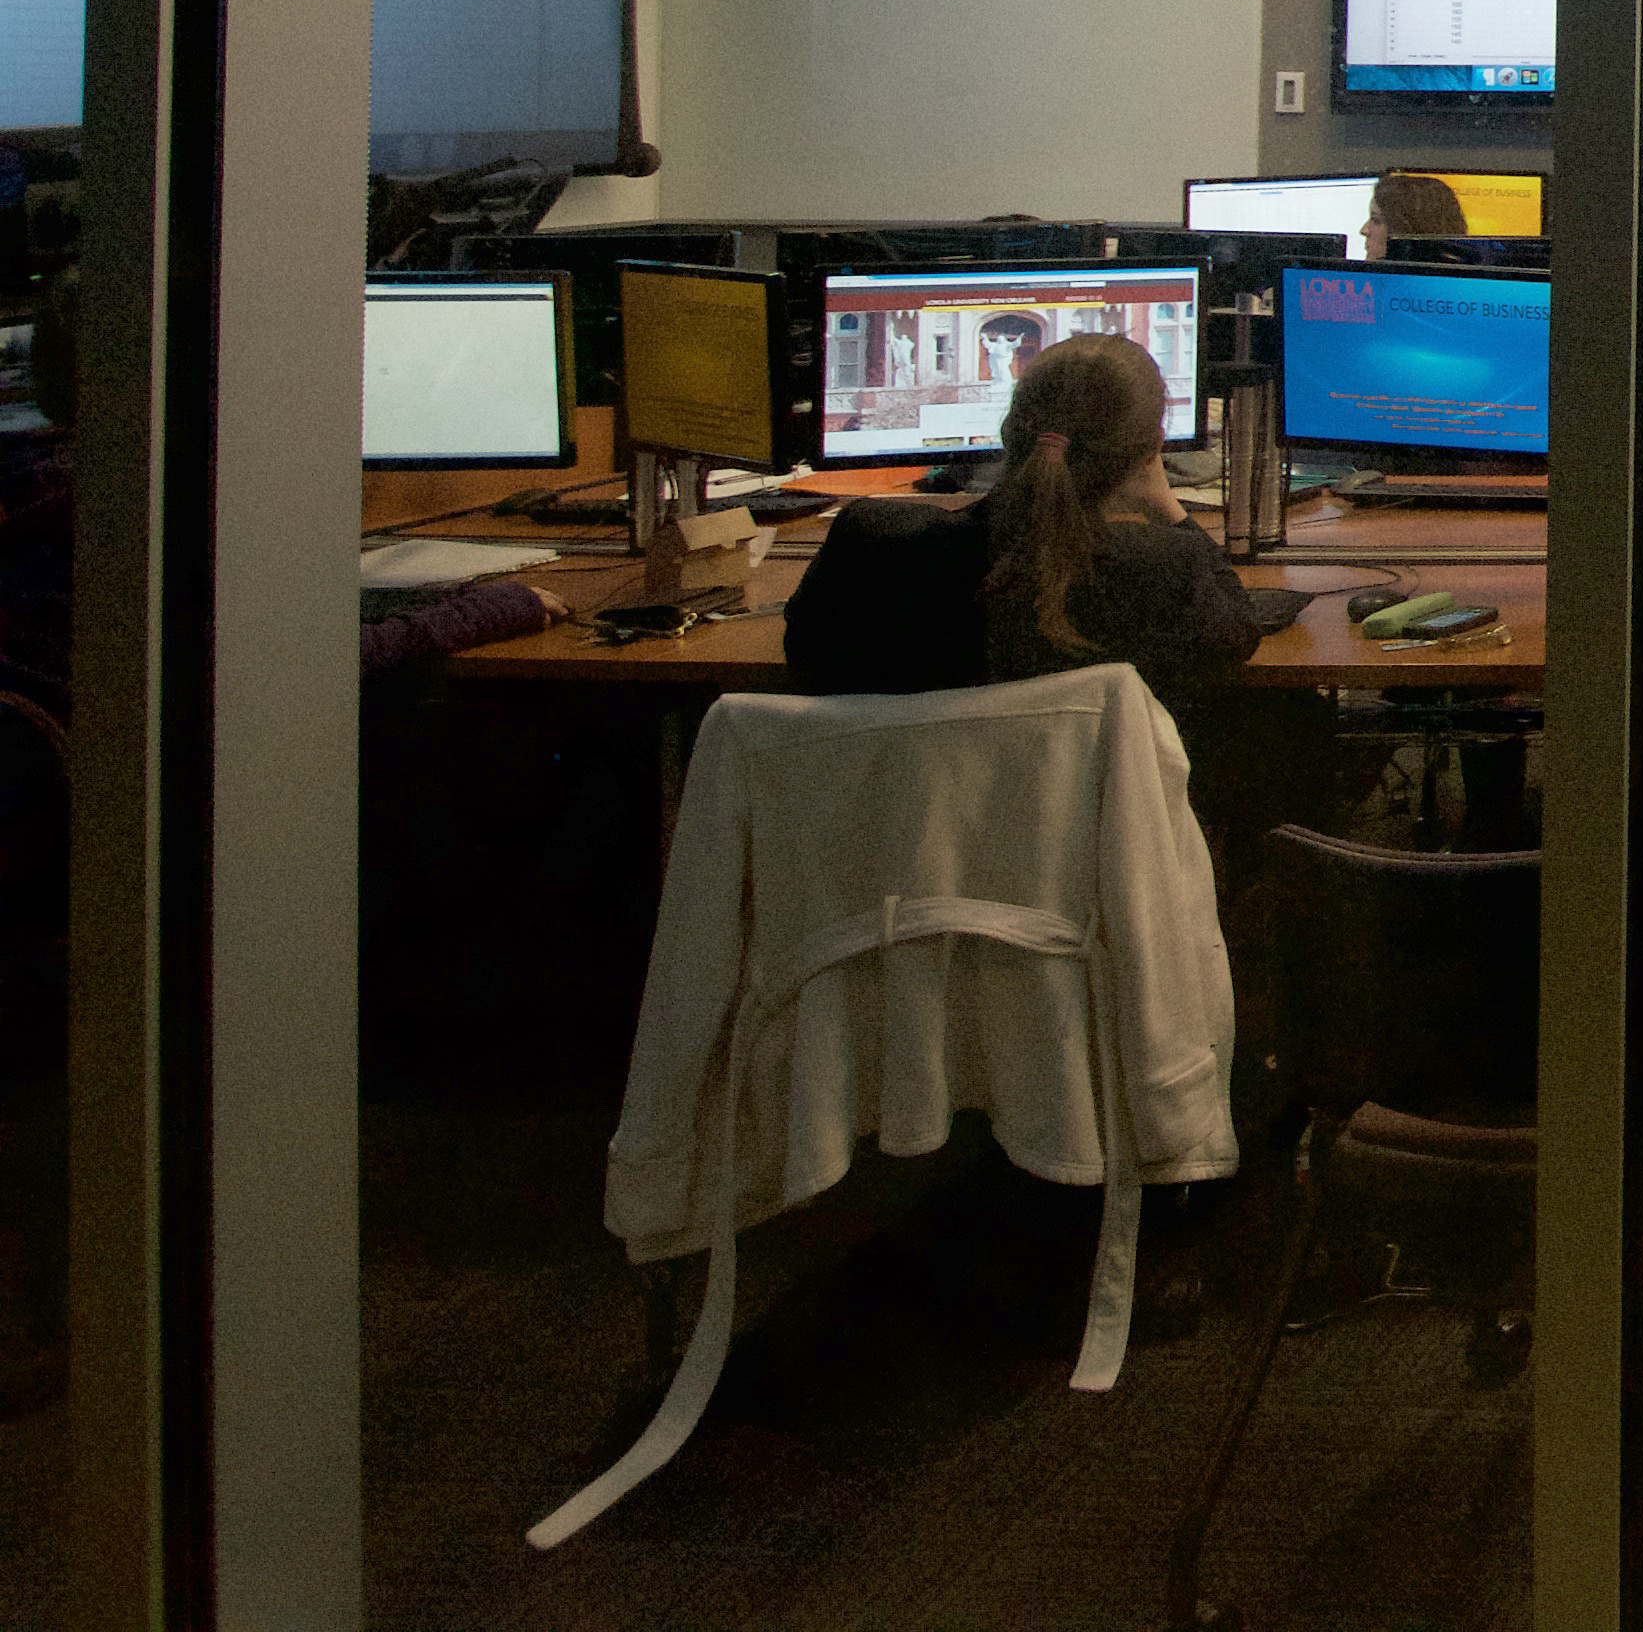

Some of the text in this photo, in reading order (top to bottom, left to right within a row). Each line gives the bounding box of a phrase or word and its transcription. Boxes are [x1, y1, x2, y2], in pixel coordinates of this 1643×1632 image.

[1390, 297, 1454, 316] COLLEGE
[1458, 302, 1477, 317] OF
[1483, 303, 1549, 321] BUSINESS
